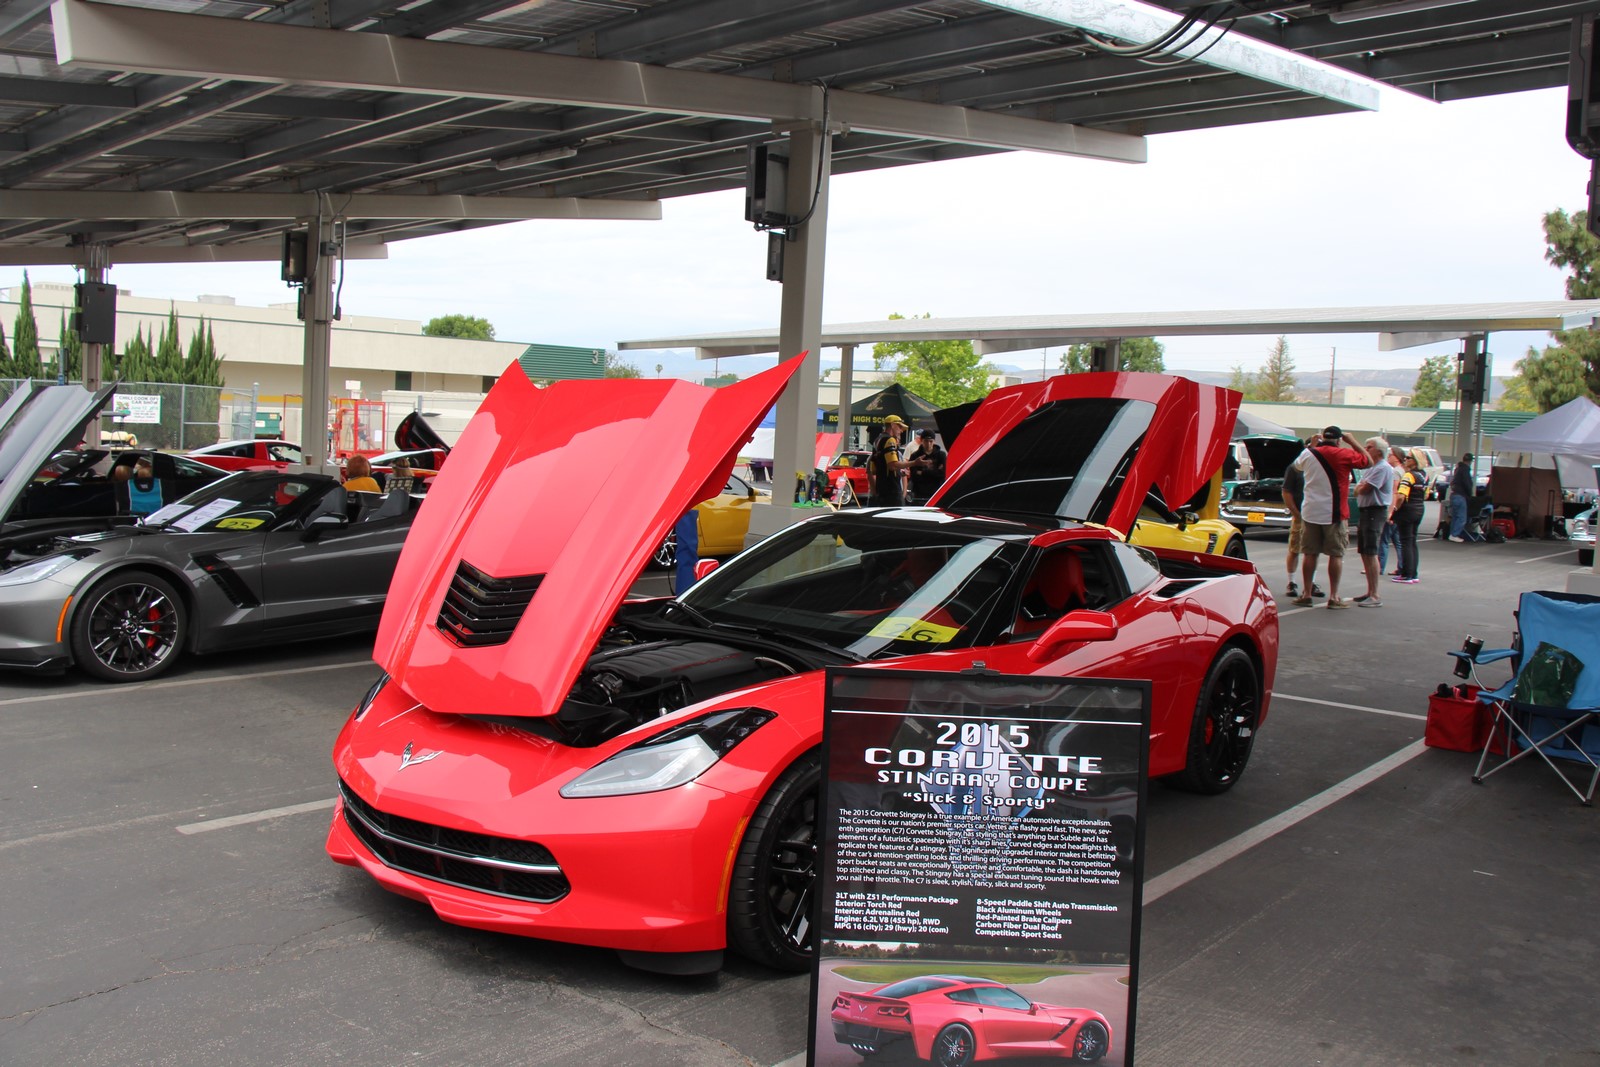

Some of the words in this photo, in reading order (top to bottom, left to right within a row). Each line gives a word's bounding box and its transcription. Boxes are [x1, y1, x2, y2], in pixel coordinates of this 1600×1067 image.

[592, 350, 599, 364] 3
[885, 623, 936, 642] 26
[936, 722, 1030, 748] 2015
[864, 748, 1102, 774] CORVETTE
[878, 770, 1000, 788] STINGRAY
[1010, 776, 1088, 791] COUPE
[903, 792, 957, 804] "Slick
[963, 794, 976, 804] &
[982, 796, 1056, 809] Sporty"
[900, 811, 926, 820] Stingray
[954, 813, 981, 822] example
[1061, 818, 1112, 828] exceptionalism.
[927, 820, 952, 829] premier
[954, 821, 974, 830] sports
[1020, 824, 1038, 833] flashy
[855, 825, 890, 834] generation
[892, 827, 905, 835] (C7)
[935, 829, 962, 838] Stingray
[976, 830, 997, 839] styling
[1018, 832, 1046, 841] anything
[838, 841, 866, 850] replicate
[920, 844, 947, 853] stingray.
[962, 846, 1000, 856] significantly
[1001, 848, 1033, 857] upgraded
[1087, 852, 1116, 861] befitting
[913, 836, 945, 845] spaceship
[972, 838, 990, 847] sharp
[991, 839, 1010, 848] lines,
[1033, 841, 1052, 850] edges
[1068, 842, 1102, 852] headlights
[837, 857, 854, 866] sport
[908, 860, 951, 870] exceptionally
[952, 862, 987, 872] supportive
[1002, 864, 1043, 874] comfortable,
[1080, 868, 1120, 877] handsomely
[873, 851, 929, 861] attention-getting
[962, 854, 988, 863] thrilling
[989, 856, 1012, 864] driving
[1013, 857, 1056, 866] performance.
[1071, 859, 1111, 869] competition
[837, 866, 848, 874] top
[890, 868, 911, 876] classy.
[925, 869, 952, 878] Stingray
[971, 871, 993, 880] special
[1021, 873, 1043, 882] tuning
[932, 878, 950, 886] sleek,
[951, 879, 974, 887] stylish,
[974, 880, 994, 888] fancy,
[1024, 882, 1046, 890] sporty.
[882, 894, 927, 902] Performance
[928, 896, 958, 905] Package
[977, 898, 1006, 907] 8-Speed
[1071, 902, 1117, 910] Transmission
[835, 914, 861, 923] Engine:
[890, 917, 906, 925] (455
[907, 917, 921, 926] hp),
[976, 913, 1020, 921] Red-Painted
[1043, 916, 1072, 925] Calipers
[863, 923, 883, 932] (city);
[895, 924, 917, 933] (hwy);
[928, 926, 949, 934] (com)
[975, 928, 1020, 938] Competition
[1021, 930, 1041, 939] Sport
